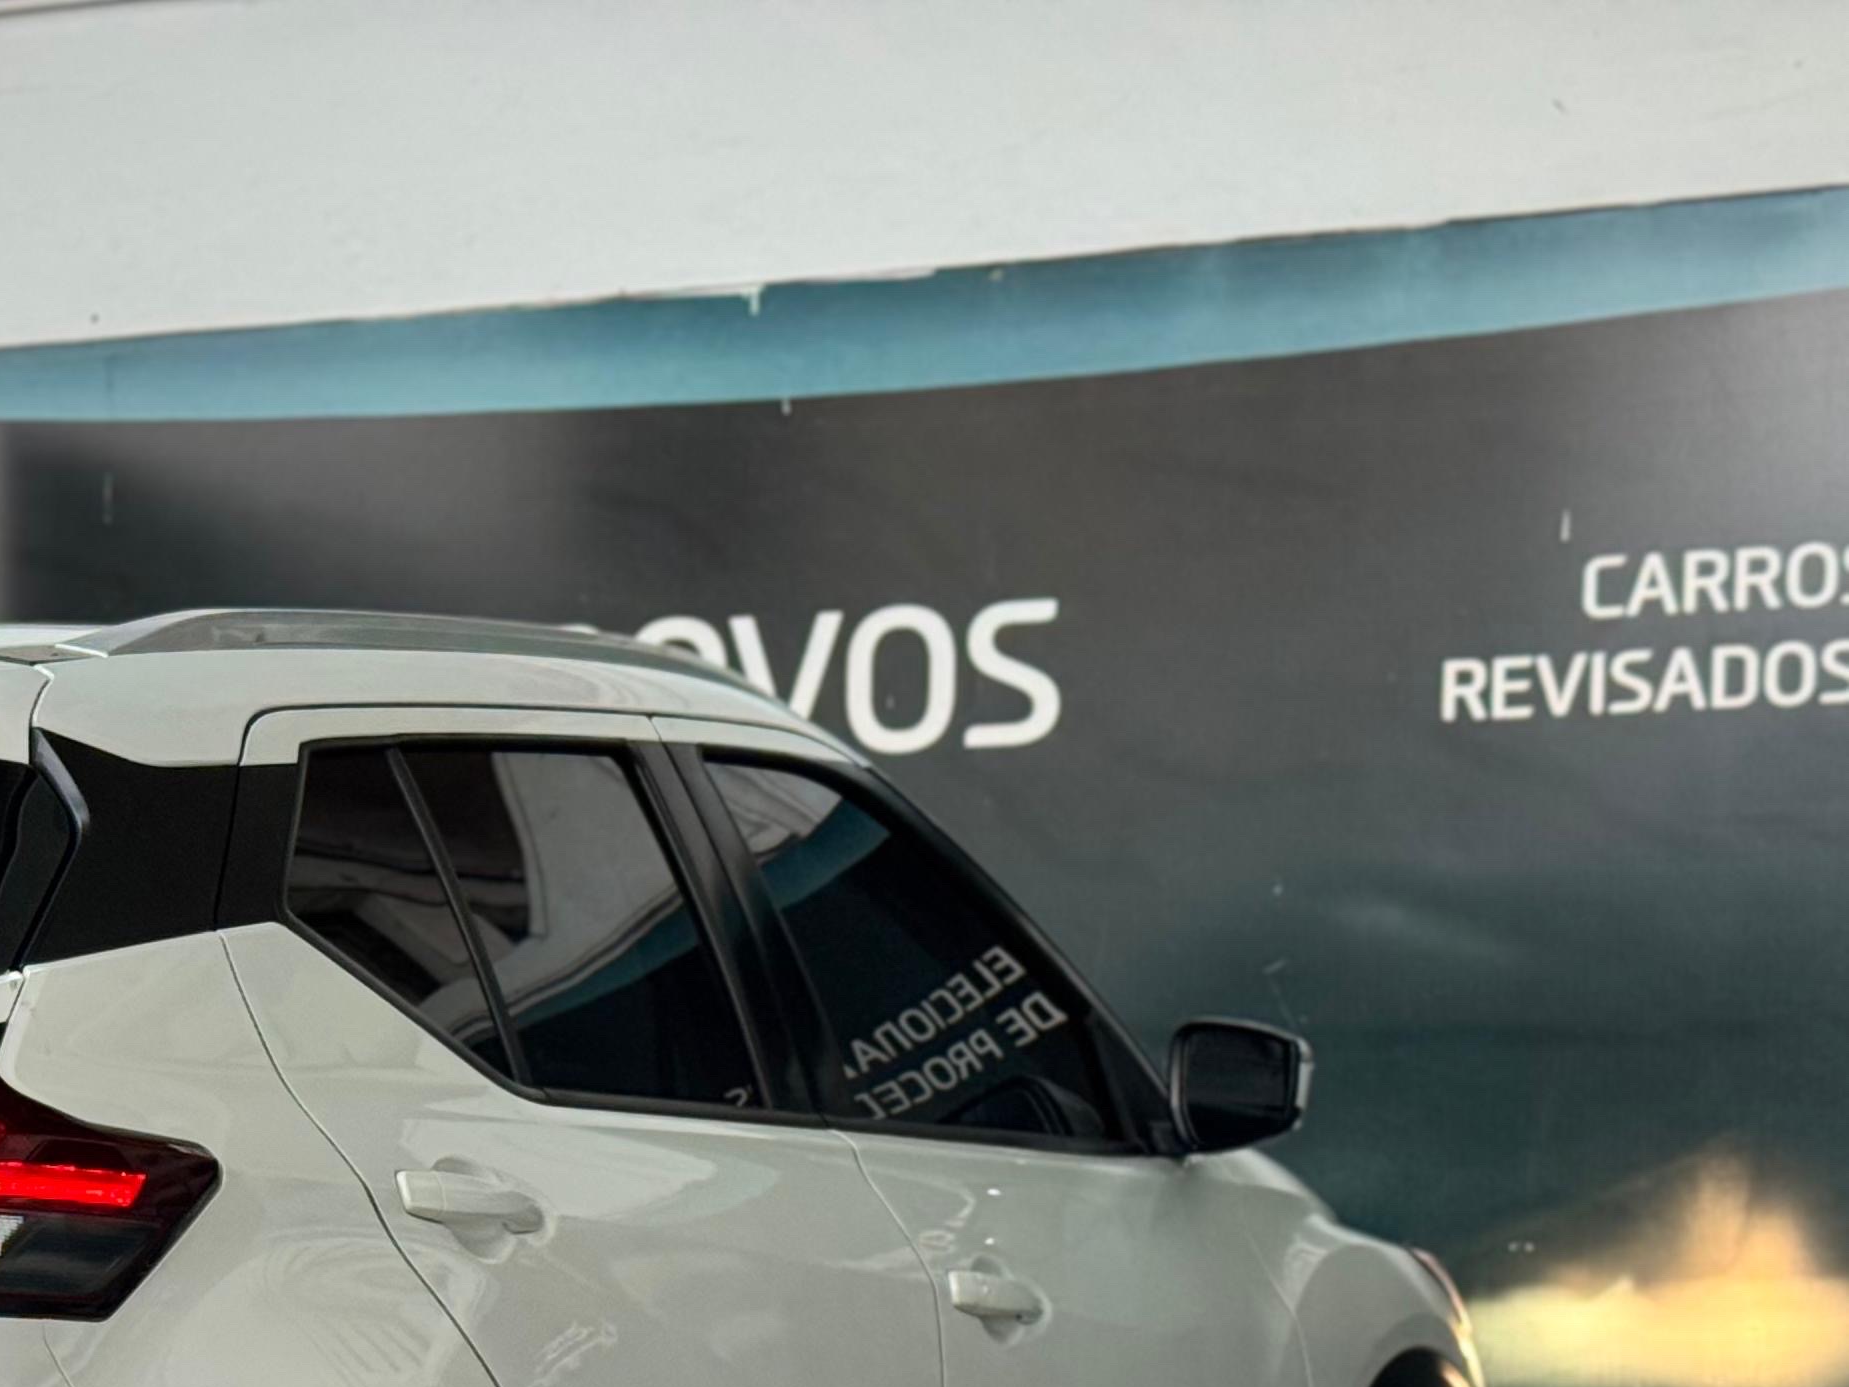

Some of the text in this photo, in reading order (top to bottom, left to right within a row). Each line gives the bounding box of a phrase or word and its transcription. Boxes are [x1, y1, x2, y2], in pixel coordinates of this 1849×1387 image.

[1581, 541, 1849, 620] CARRO
[558, 597, 1062, 756] VOS
[1440, 637, 1849, 723] REVISADOS
